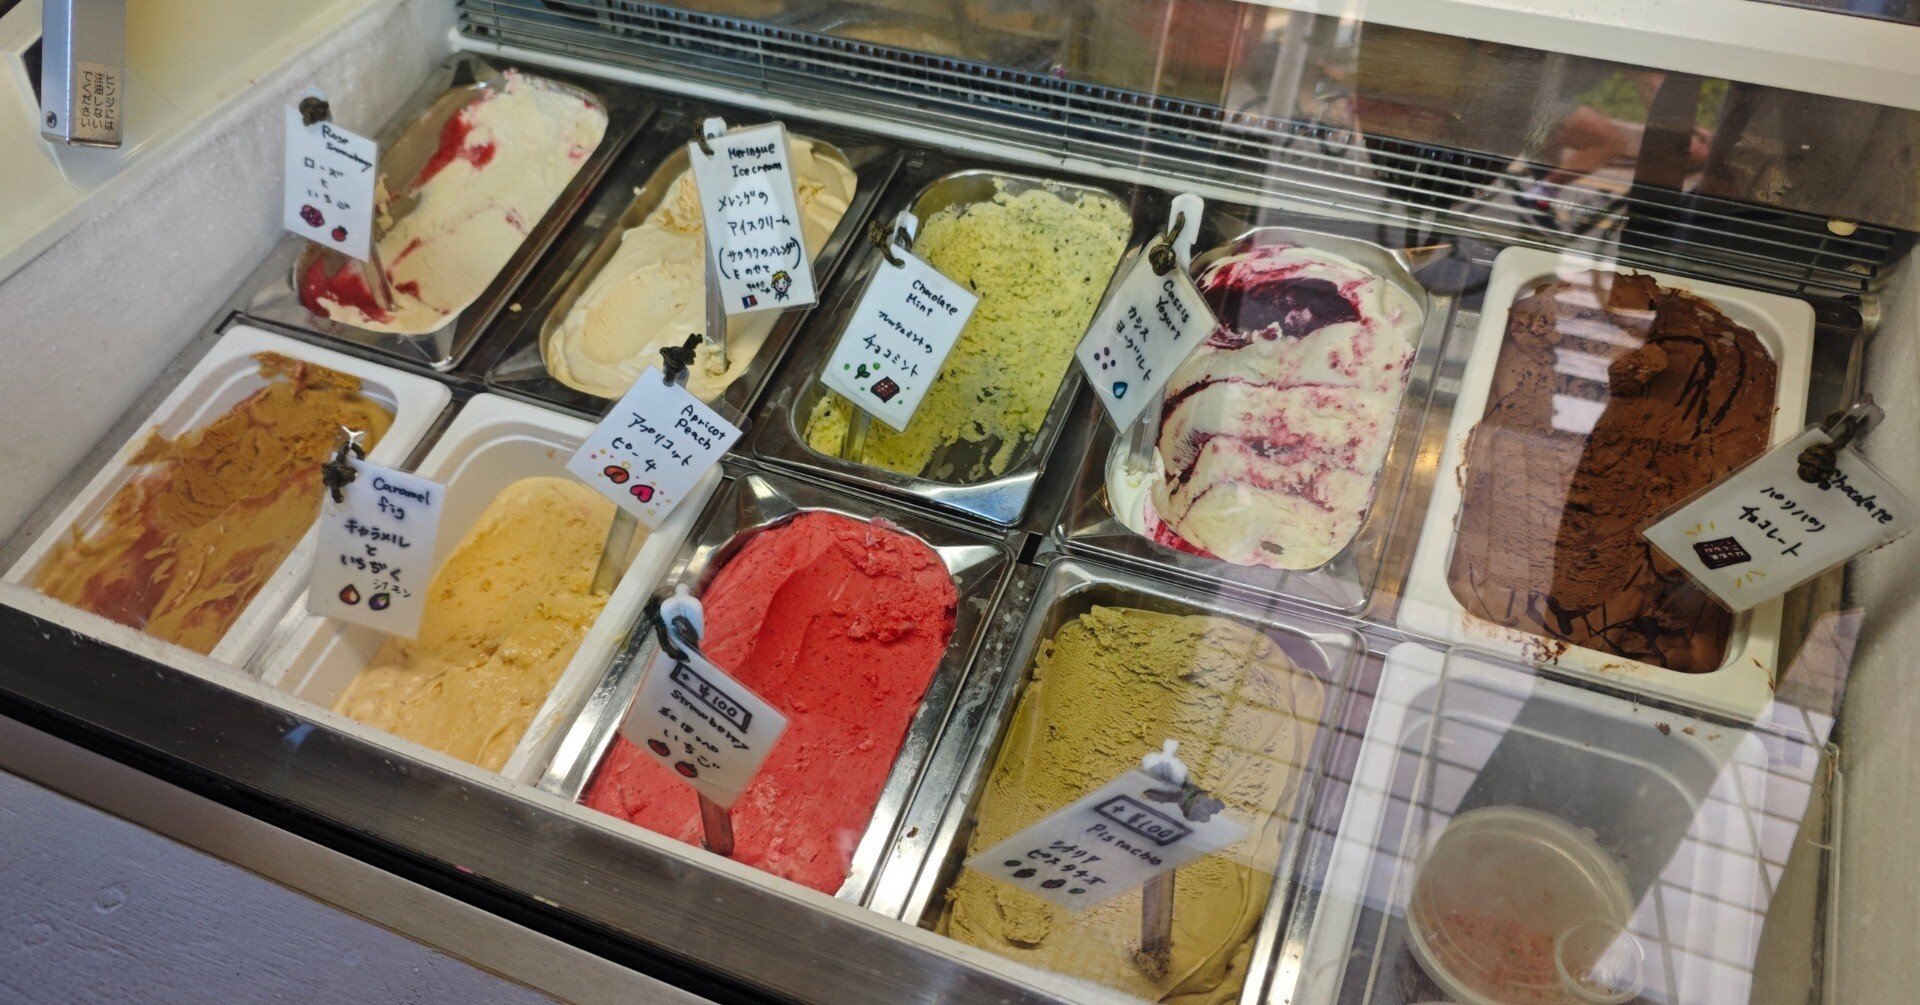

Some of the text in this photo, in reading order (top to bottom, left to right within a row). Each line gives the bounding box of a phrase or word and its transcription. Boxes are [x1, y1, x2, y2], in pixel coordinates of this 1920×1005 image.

[81, 70, 92, 128] てください
[92, 72, 104, 129] 注油しない
[105, 74, 115, 131] ヒンジには
[321, 125, 349, 144] Rose
[728, 143, 776, 160] Meringue
[304, 157, 344, 178] ローズ
[321, 178, 329, 189] と
[307, 189, 350, 210] いちご
[718, 191, 769, 212] メレンゲの
[728, 215, 791, 236] アイスクリーム
[906, 293, 933, 316] Mint
[912, 279, 958, 316] Chocolate
[1163, 280, 1190, 323] Cassis
[1128, 306, 1149, 342] カシス
[1155, 296, 1181, 341] Yogurt
[863, 334, 919, 377] チョコミント
[1116, 320, 1152, 382] ヨーグルト
[628, 412, 693, 467] アプリコット
[680, 404, 726, 441] Apricot
[611, 436, 657, 472] ピーチ
[373, 477, 430, 505] Caramel
[1760, 486, 1826, 533] パリパリ
[344, 518, 411, 548] キャラメル
[1738, 505, 1803, 557] チョコレート
[365, 544, 377, 557] と
[663, 729, 721, 769] いちご
[1027, 849, 1106, 886] ピスタチオ
